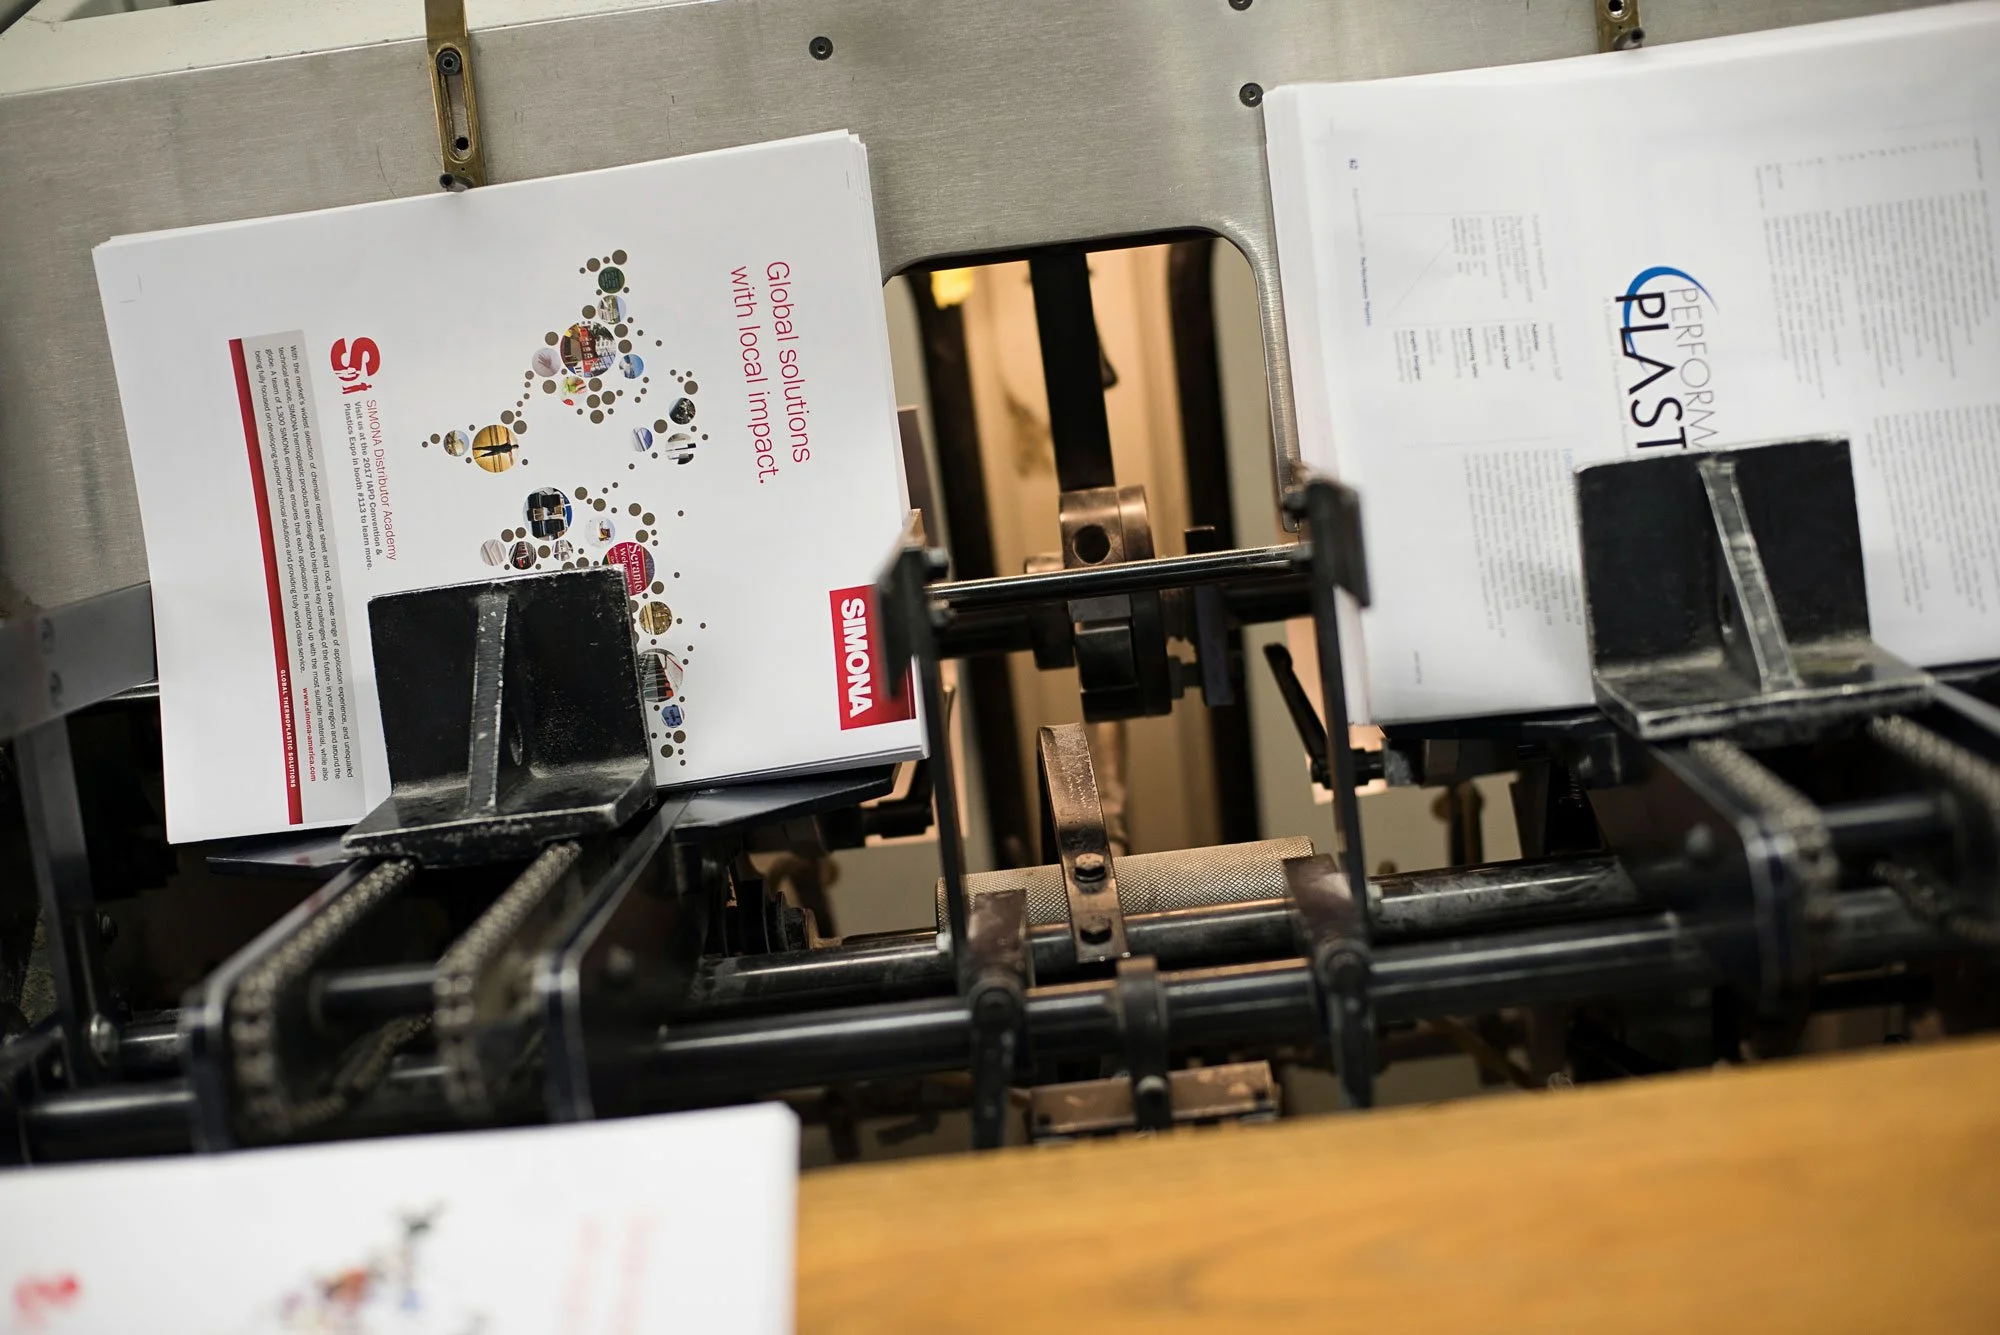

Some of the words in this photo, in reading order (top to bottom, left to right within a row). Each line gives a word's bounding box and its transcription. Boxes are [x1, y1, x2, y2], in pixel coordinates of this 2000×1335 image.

[730, 265, 757, 318] with
[766, 261, 799, 341] Global
[254, 350, 263, 370] being
[264, 348, 274, 369] globe.
[278, 346, 289, 377] technical
[290, 344, 298, 361] With
[738, 325, 768, 383] local
[258, 369, 266, 384] fully
[292, 362, 300, 374] the
[1615, 292, 1686, 448] PLAST
[1668, 287, 1721, 450] PERFORM
[271, 376, 279, 395] team
[283, 377, 292, 404] service,
[295, 375, 306, 406] market's
[260, 384, 271, 412] focused
[778, 349, 810, 463] solutions
[265, 412, 272, 422] on
[275, 405, 286, 426] 1,300
[287, 403, 298, 432] SIMONA
[300, 406, 310, 429] widest
[343, 402, 354, 435] Plastics
[354, 401, 363, 419] Visit
[357, 420, 364, 431] us
[366, 399, 383, 447] SIMONA
[266, 422, 278, 459] developing
[279, 426, 290, 456] SIMONA
[304, 430, 314, 461] selection
[348, 436, 357, 456] Expo
[358, 432, 366, 441] at
[746, 391, 779, 484] impact.
[292, 431, 305, 478] thermoplastic
[360, 441, 368, 456] the
[272, 458, 282, 486] superior
[351, 457, 359, 466] in
[362, 457, 373, 479] 2017
[284, 456, 295, 493] employees
[353, 467, 363, 490] booth
[373, 448, 390, 507] Distributor
[298, 478, 309, 508] products
[310, 471, 321, 502] chemical
[366, 480, 376, 501] IAPD
[276, 487, 287, 518] technical
[289, 493, 299, 521] ensures
[357, 492, 367, 514] #113
[303, 508, 311, 520] are
[315, 503, 325, 533] resistant
[360, 514, 367, 524] to
[369, 501, 381, 547] Convention
[281, 518, 291, 549] solutions
[294, 521, 302, 536] that
[305, 519, 316, 551] designed
[361, 524, 370, 546] learn
[382, 510, 397, 561] Academy
[295, 537, 304, 554] each
[319, 533, 328, 553] sheet
[375, 548, 383, 556] &
[285, 549, 294, 563] and
[309, 550, 316, 559] to
[322, 554, 330, 568] and
[364, 547, 373, 571] more.
[297, 555, 308, 592] application
[310, 558, 318, 574] help
[324, 569, 332, 584] rod,
[286, 563, 297, 595] providing
[312, 574, 321, 592] meet
[291, 594, 299, 610] truly
[314, 592, 322, 605] key
[326, 591, 335, 616] diverse
[293, 609, 302, 629] world
[304, 600, 314, 631] matched
[316, 605, 326, 641] challenges
[295, 629, 303, 647] class
[307, 631, 314, 641] up
[330, 617, 338, 637] range
[309, 642, 317, 657] with
[320, 641, 329, 649] of
[321, 648, 329, 661] the
[297, 647, 306, 673] service.
[310, 657, 318, 670] the
[333, 648, 343, 685] application
[840, 597, 873, 718] SIMONA
[280, 669, 288, 695] GLOBAL
[312, 670, 320, 688] most
[323, 661, 331, 682] future
[325, 692, 334, 708] your
[326, 685, 332, 693] in
[314, 689, 323, 716] suitable
[337, 686, 347, 725] experience,
[282, 696, 293, 751] THERMOPLASTIC
[327, 708, 336, 730] region
[302, 687, 316, 782] www.simona-america.com
[317, 717, 327, 747] material,
[330, 730, 338, 744] and
[342, 726, 350, 740] and
[320, 747, 328, 766] while
[331, 744, 341, 768] around
[287, 752, 296, 788] SOLUTIONS
[321, 766, 329, 782] also
